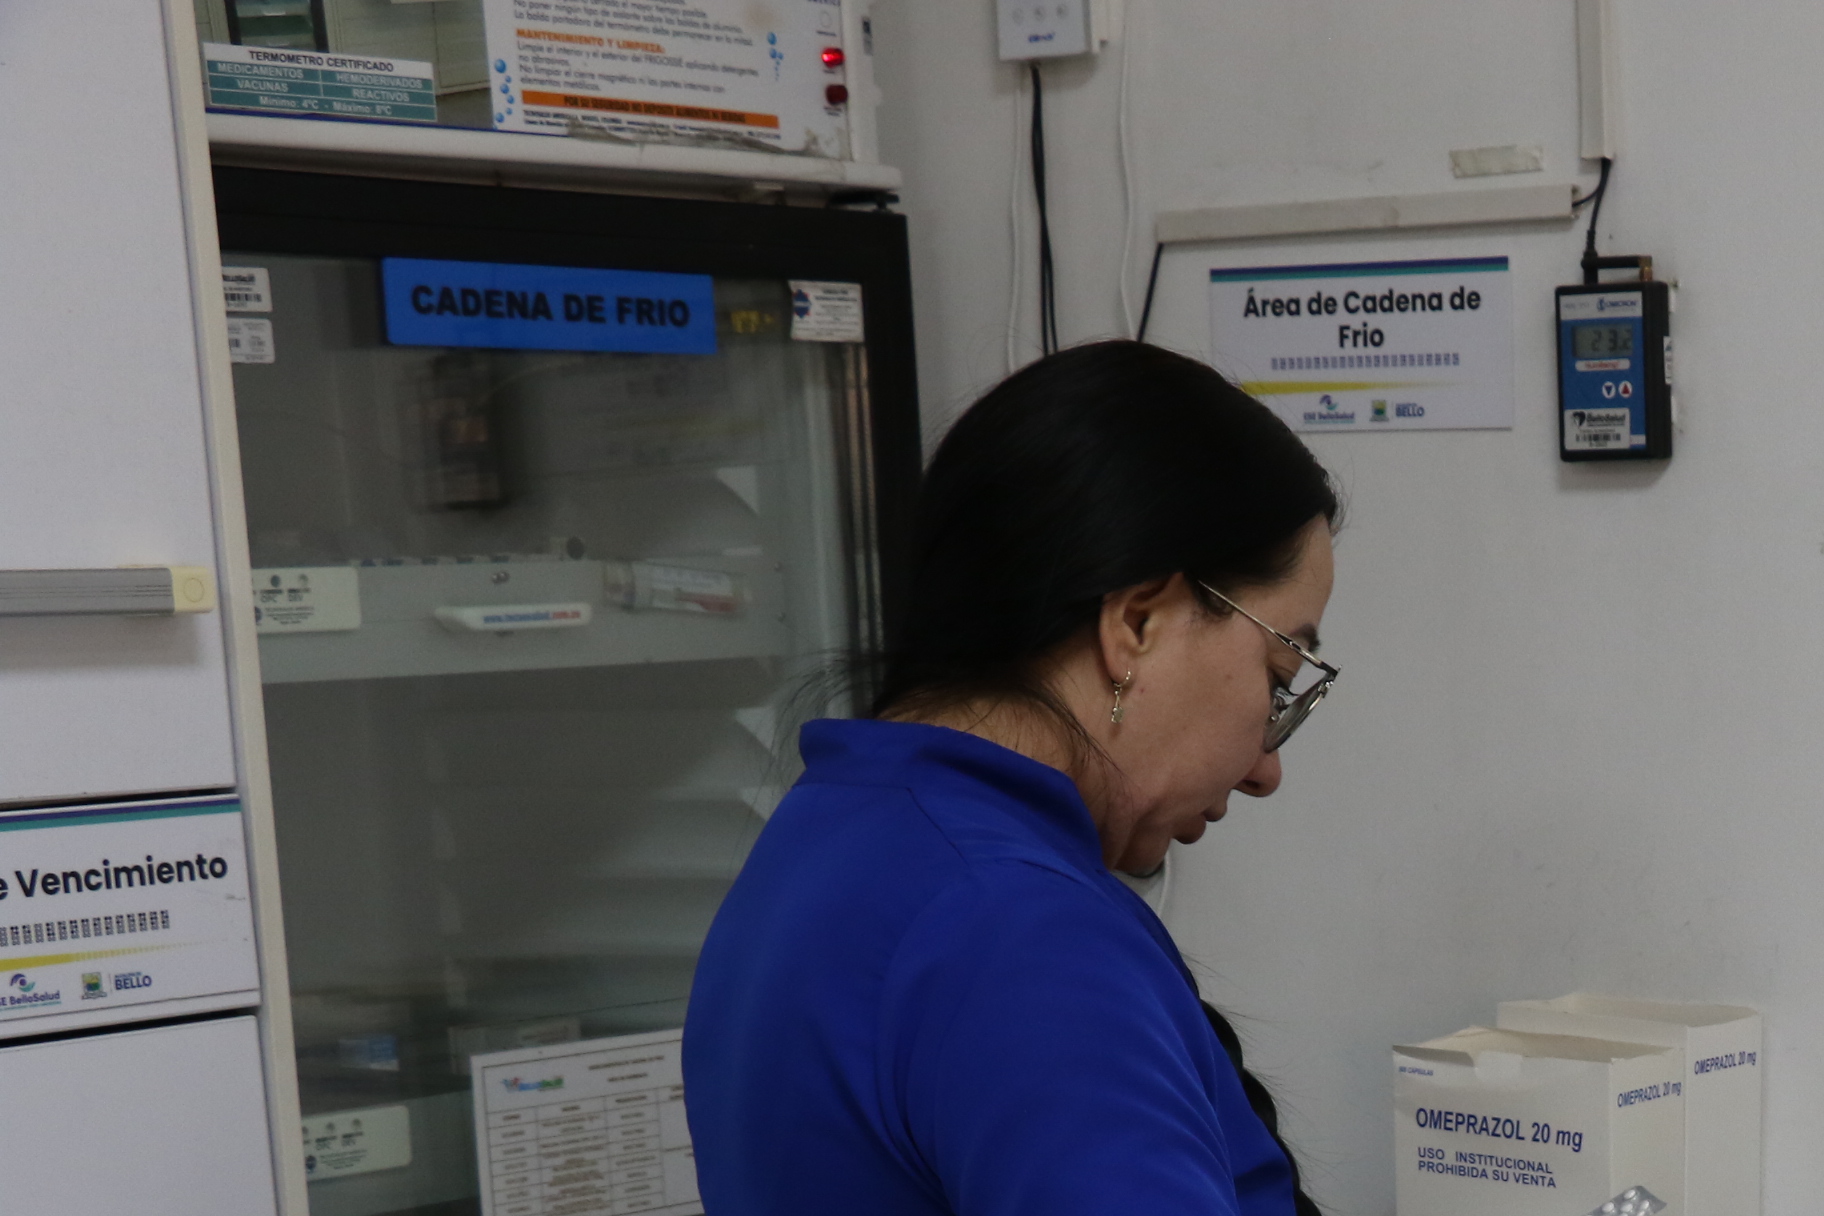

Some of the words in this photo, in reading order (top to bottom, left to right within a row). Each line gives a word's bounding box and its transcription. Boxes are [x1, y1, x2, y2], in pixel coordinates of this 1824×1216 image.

[217, 62, 304, 79] MEDICAMENTOS
[250, 51, 324, 66] TERMOMETRO
[326, 57, 394, 72] CERTIFICADO
[237, 79, 289, 93] VACUNAS
[336, 73, 423, 89] HEMODERIVADOS
[352, 88, 410, 102] REACTIVOS
[411, 284, 552, 321] CADENA
[563, 292, 607, 324] DE
[616, 296, 691, 328] FRIO
[1243, 287, 1302, 319] Área
[1306, 291, 1339, 316] de
[1343, 287, 1446, 316] Cadena
[1449, 286, 1481, 312] de
[1338, 322, 1385, 350] Frio
[14, 853, 229, 898] Vencimiento
[114, 974, 153, 991] BELLO
[9, 989, 61, 1006] BelloSalud
[1694, 1052, 1737, 1076] OMEPRAZOL
[1617, 1083, 1661, 1109] OMEPRAZOL
[1416, 1107, 1526, 1141] OMEPRAZOL
[1531, 1121, 1551, 1144] 20
[1555, 1128, 1584, 1153] mg
[1418, 1146, 1446, 1161] USO
[1455, 1151, 1554, 1175] INSTITUCIONAL
[1418, 1160, 1490, 1180] PROHIBIDA
[1492, 1168, 1510, 1183] SU
[1513, 1172, 1558, 1189] VENTA
